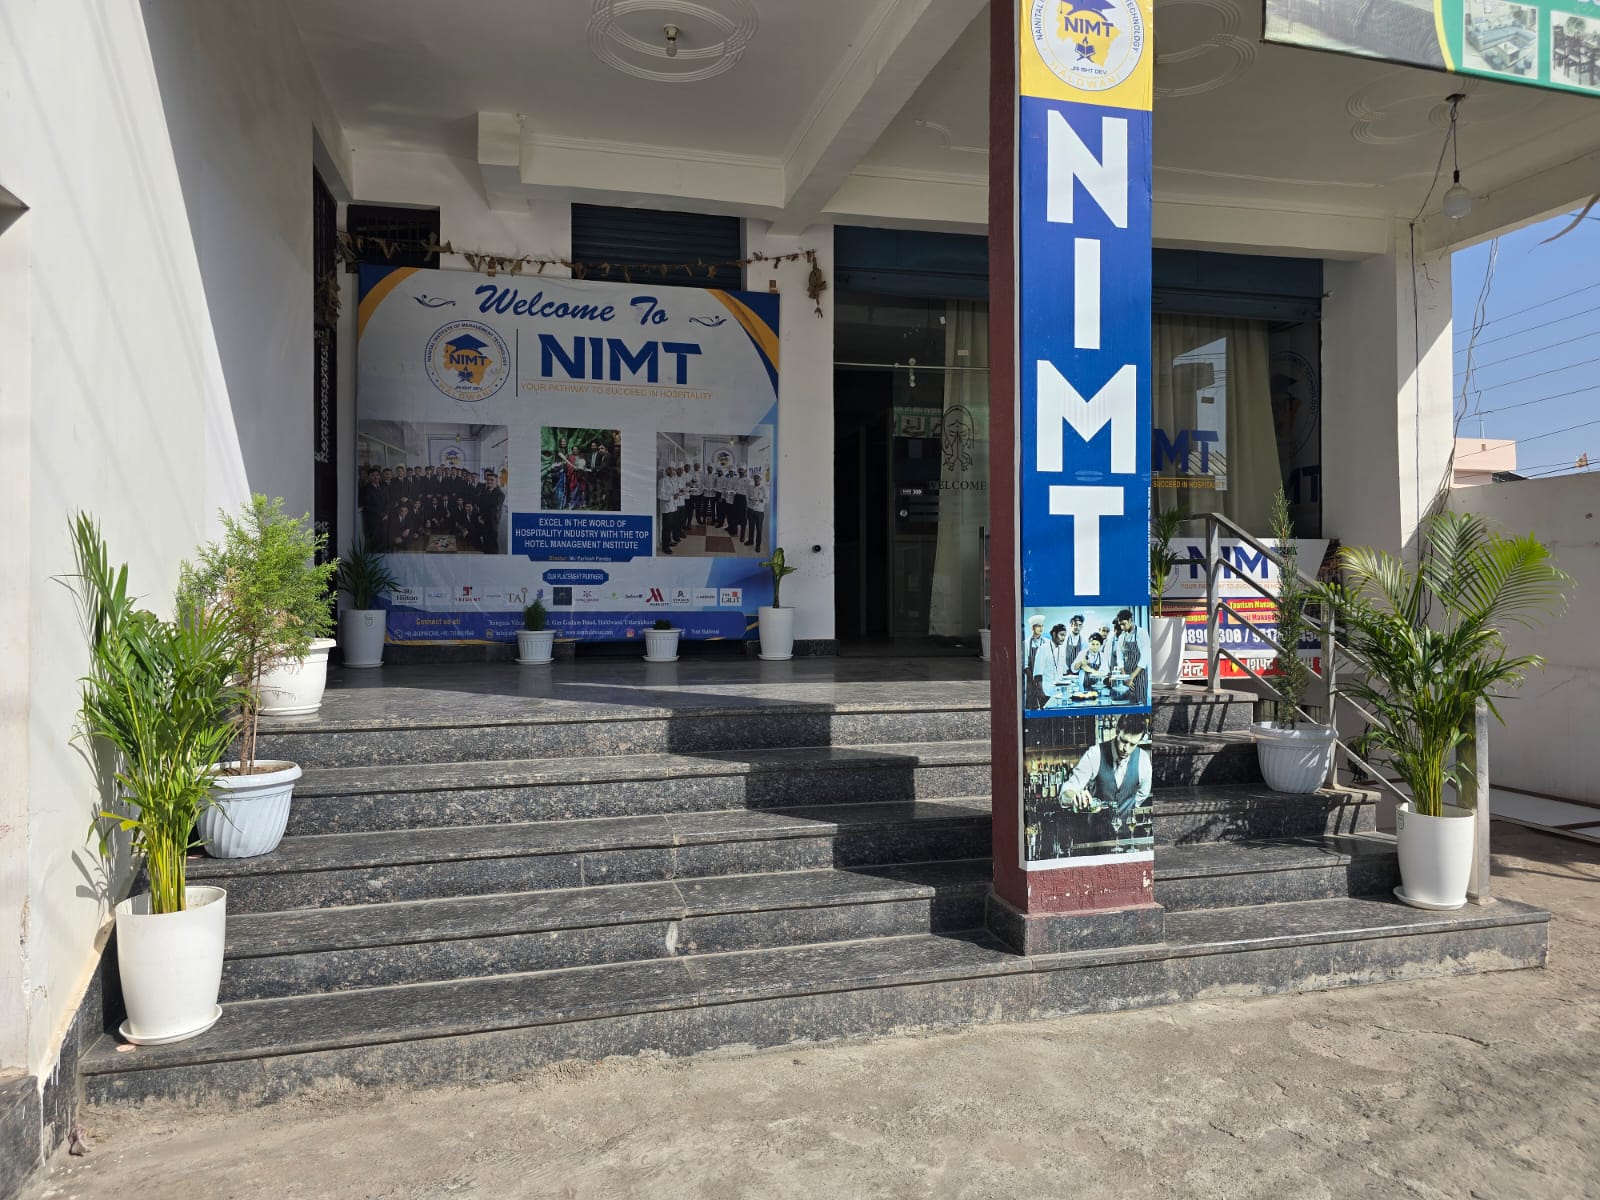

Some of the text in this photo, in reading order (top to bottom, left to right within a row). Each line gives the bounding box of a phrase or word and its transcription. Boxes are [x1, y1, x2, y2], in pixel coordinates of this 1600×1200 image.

[1064, 16, 1114, 38] NIMT
[475, 284, 670, 326] Welcome To
[538, 334, 702, 385] NIMT
[1036, 109, 1137, 597] NIMT
[449, 354, 488, 367] NIMT
[520, 383, 713, 400] YOUR PATHWAY TO SUCCEED IN HOSPITALITY
[928, 480, 987, 490] WELCOME
[1152, 480, 1181, 488] SUCCEED
[1182, 480, 1188, 488] IN
[538, 518, 627, 528] EXCEL IN THE WORLD OF
[515, 528, 649, 539] HOSPITALITY INDUSTRY WITH THE TOP
[524, 540, 639, 550] HOTEL MANAGEMENT INSTITUTE
[507, 591, 528, 604] TAJ
[1230, 600, 1254, 609] Tourism
